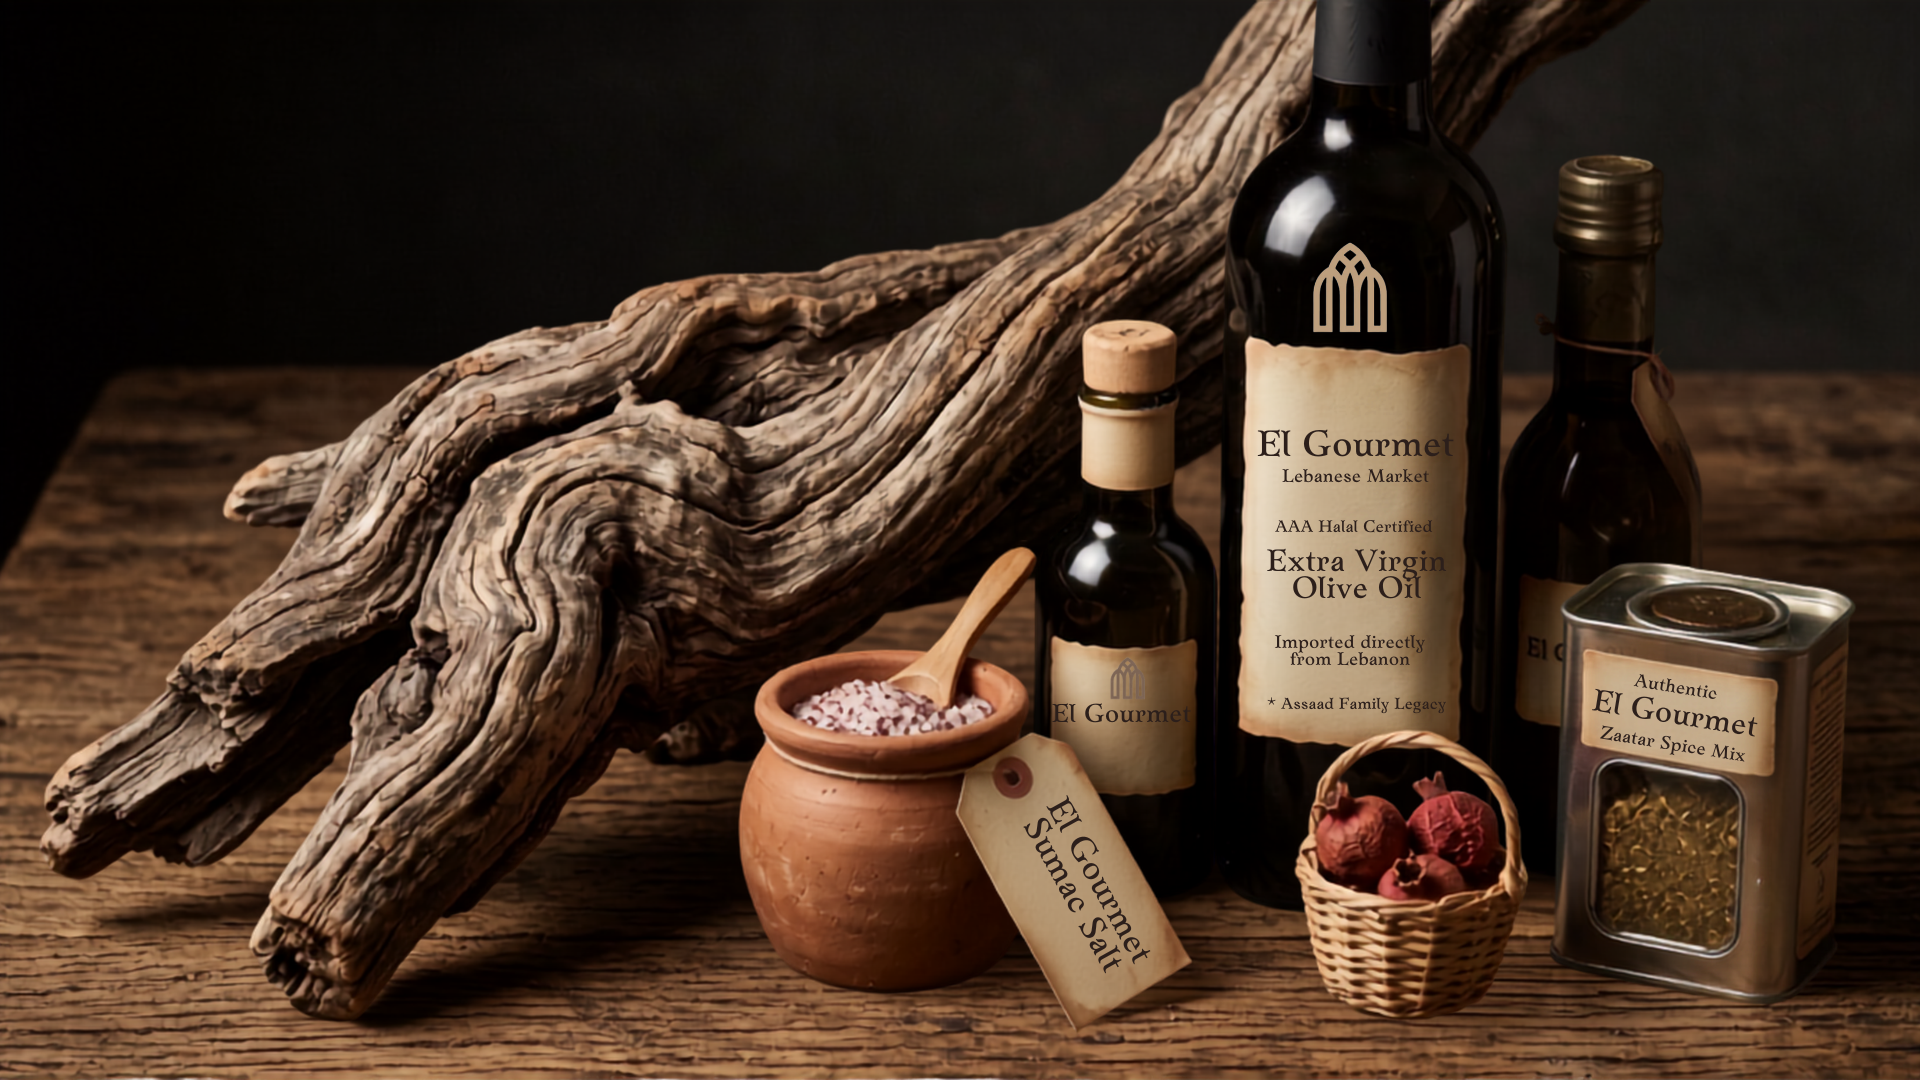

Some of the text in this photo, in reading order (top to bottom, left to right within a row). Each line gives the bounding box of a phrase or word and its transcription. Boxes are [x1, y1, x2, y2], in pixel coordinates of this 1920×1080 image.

[1257, 429, 1454, 458] El Gourmet
[1282, 468, 1430, 483] Lebanese Market
[1275, 519, 1433, 533] AAA Halal Certified
[1266, 548, 1447, 580] Extra Virgin
[1292, 575, 1422, 599] Olive Oil
[1274, 634, 1426, 653] Imported directly
[1527, 635, 1547, 661] El
[1290, 651, 1411, 666] from Lebanon
[1633, 673, 1718, 700] Authentic
[1052, 703, 1191, 723] El Gourmet
[1281, 697, 1447, 714] Assaad Family Legacy
[1592, 688, 1758, 738] El Gourmet
[1600, 725, 1746, 762] Zaatar Spice Mix
[1046, 795, 1151, 965] El Gourmet
[1023, 817, 1122, 974] Sumac Salt
